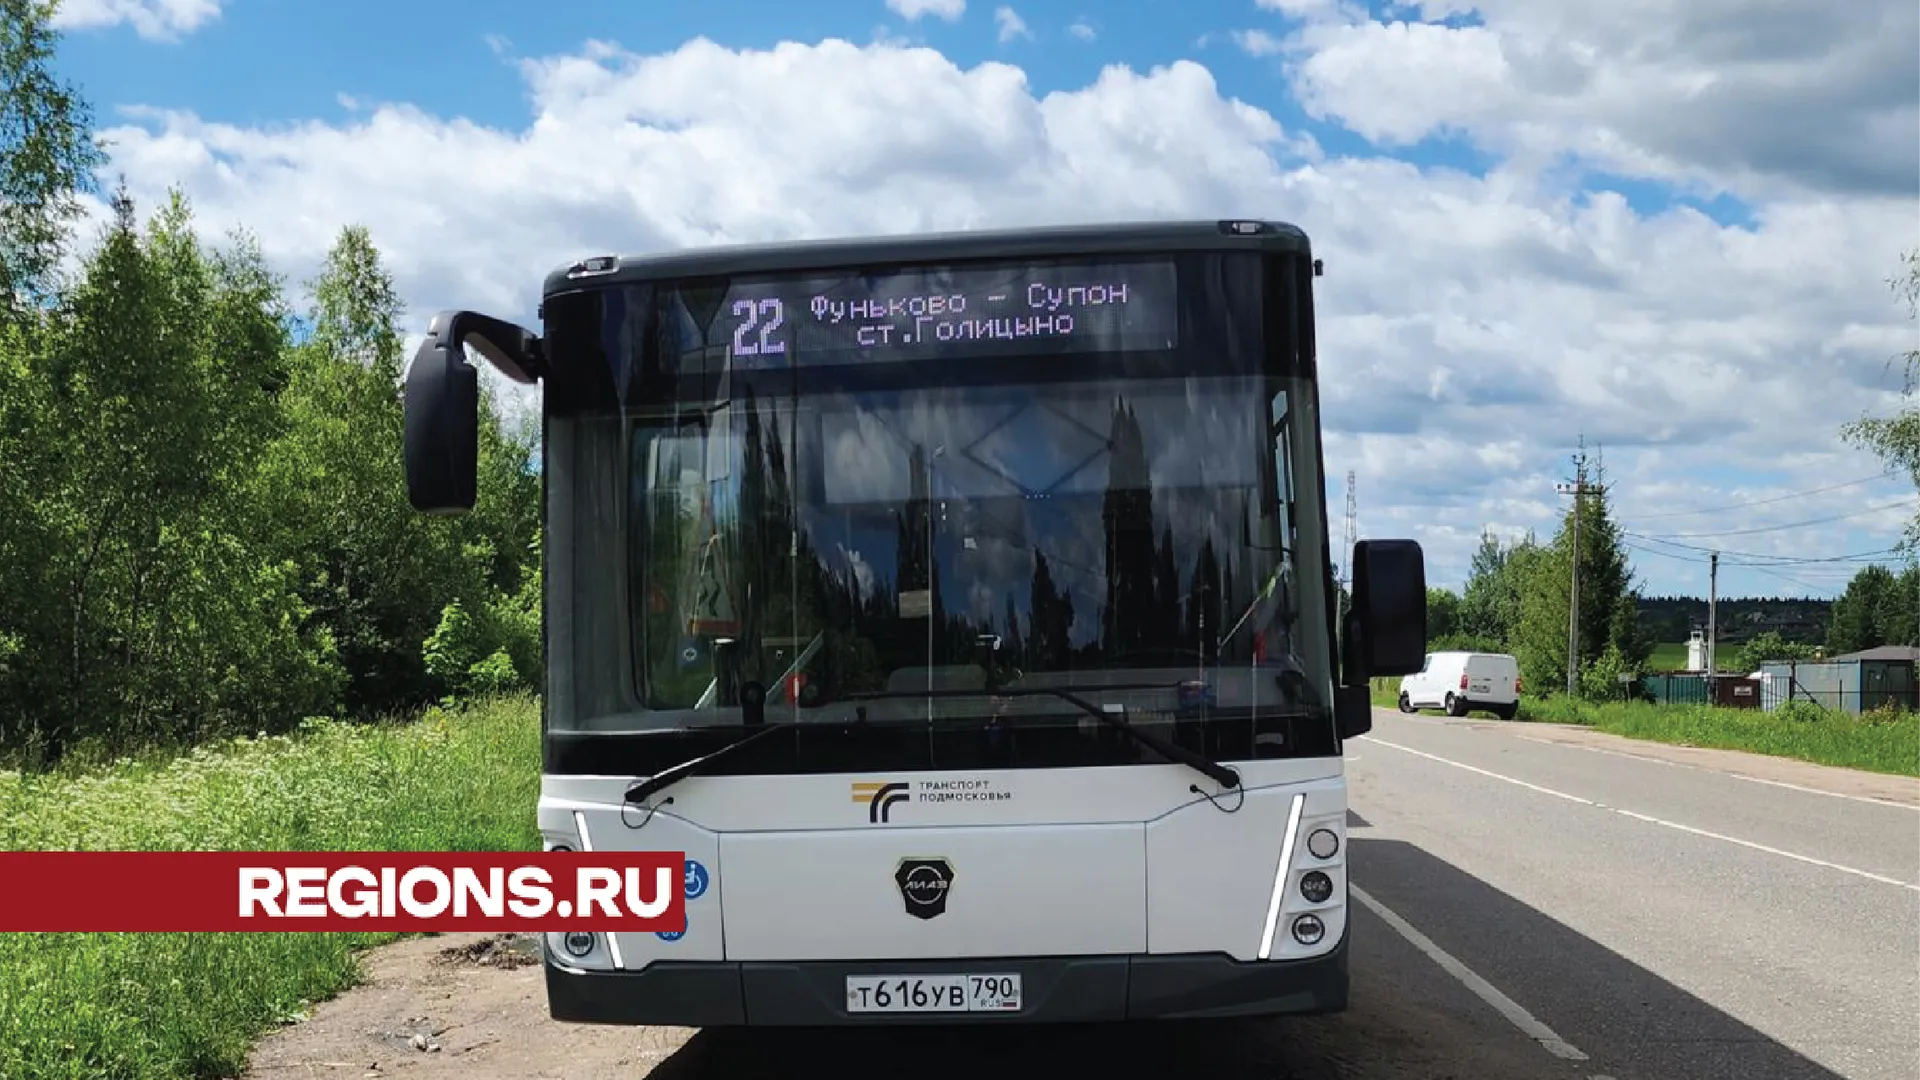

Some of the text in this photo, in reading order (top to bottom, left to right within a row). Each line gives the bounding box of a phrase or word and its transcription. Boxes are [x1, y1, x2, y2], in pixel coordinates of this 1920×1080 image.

[732, 298, 785, 356] 22
[810, 294, 967, 324] Фуньково
[1027, 283, 1129, 311] Супон
[857, 314, 1074, 346] ст.Голицыно
[919, 780, 990, 791] ТРАНСПОРТ
[919, 792, 1011, 803] ПОДМОСКОВЬЯ
[971, 977, 1013, 999] 790
